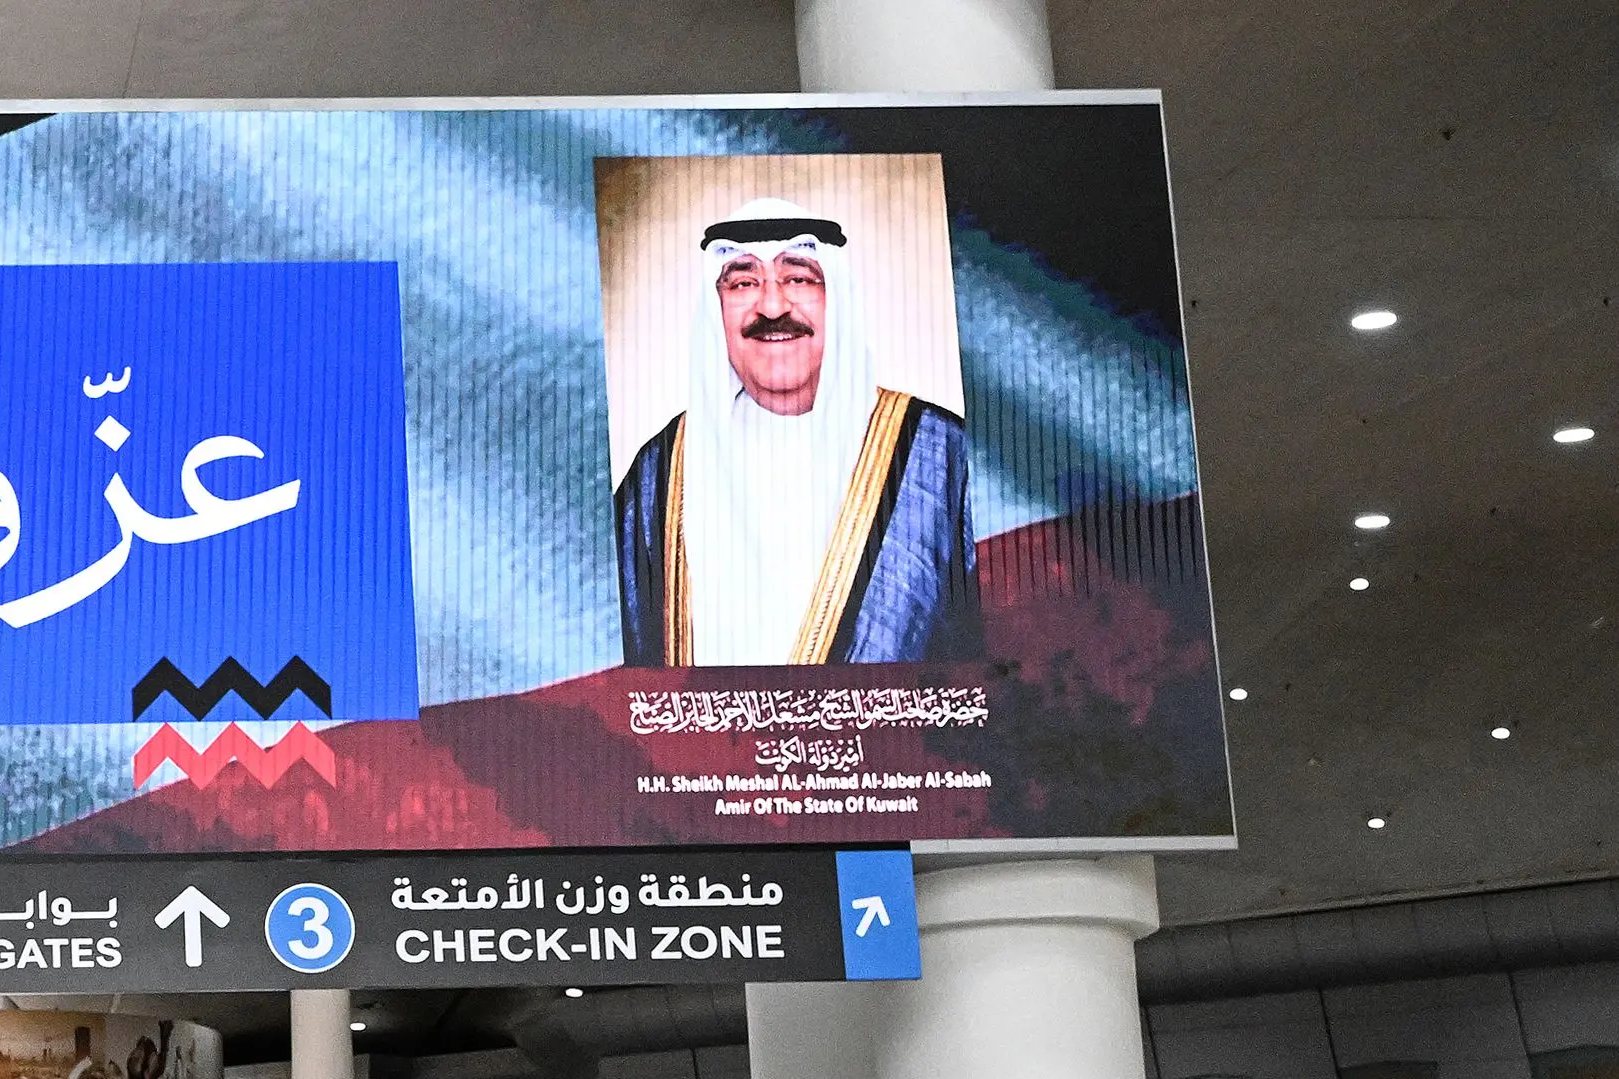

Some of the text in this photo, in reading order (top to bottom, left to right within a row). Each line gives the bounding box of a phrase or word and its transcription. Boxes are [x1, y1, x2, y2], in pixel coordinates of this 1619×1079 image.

[672, 775, 723, 792] Sheikh
[726, 774, 779, 791] Meshal
[861, 772, 922, 790] Al-Jaber
[925, 770, 992, 788] Al-Sabah
[715, 795, 919, 815] Amir Of The State Of Kuwait
[391, 874, 784, 915] منطقة وزن الأمتعة
[287, 898, 334, 958] 3
[395, 925, 784, 963] CHECK-IN ZONE
